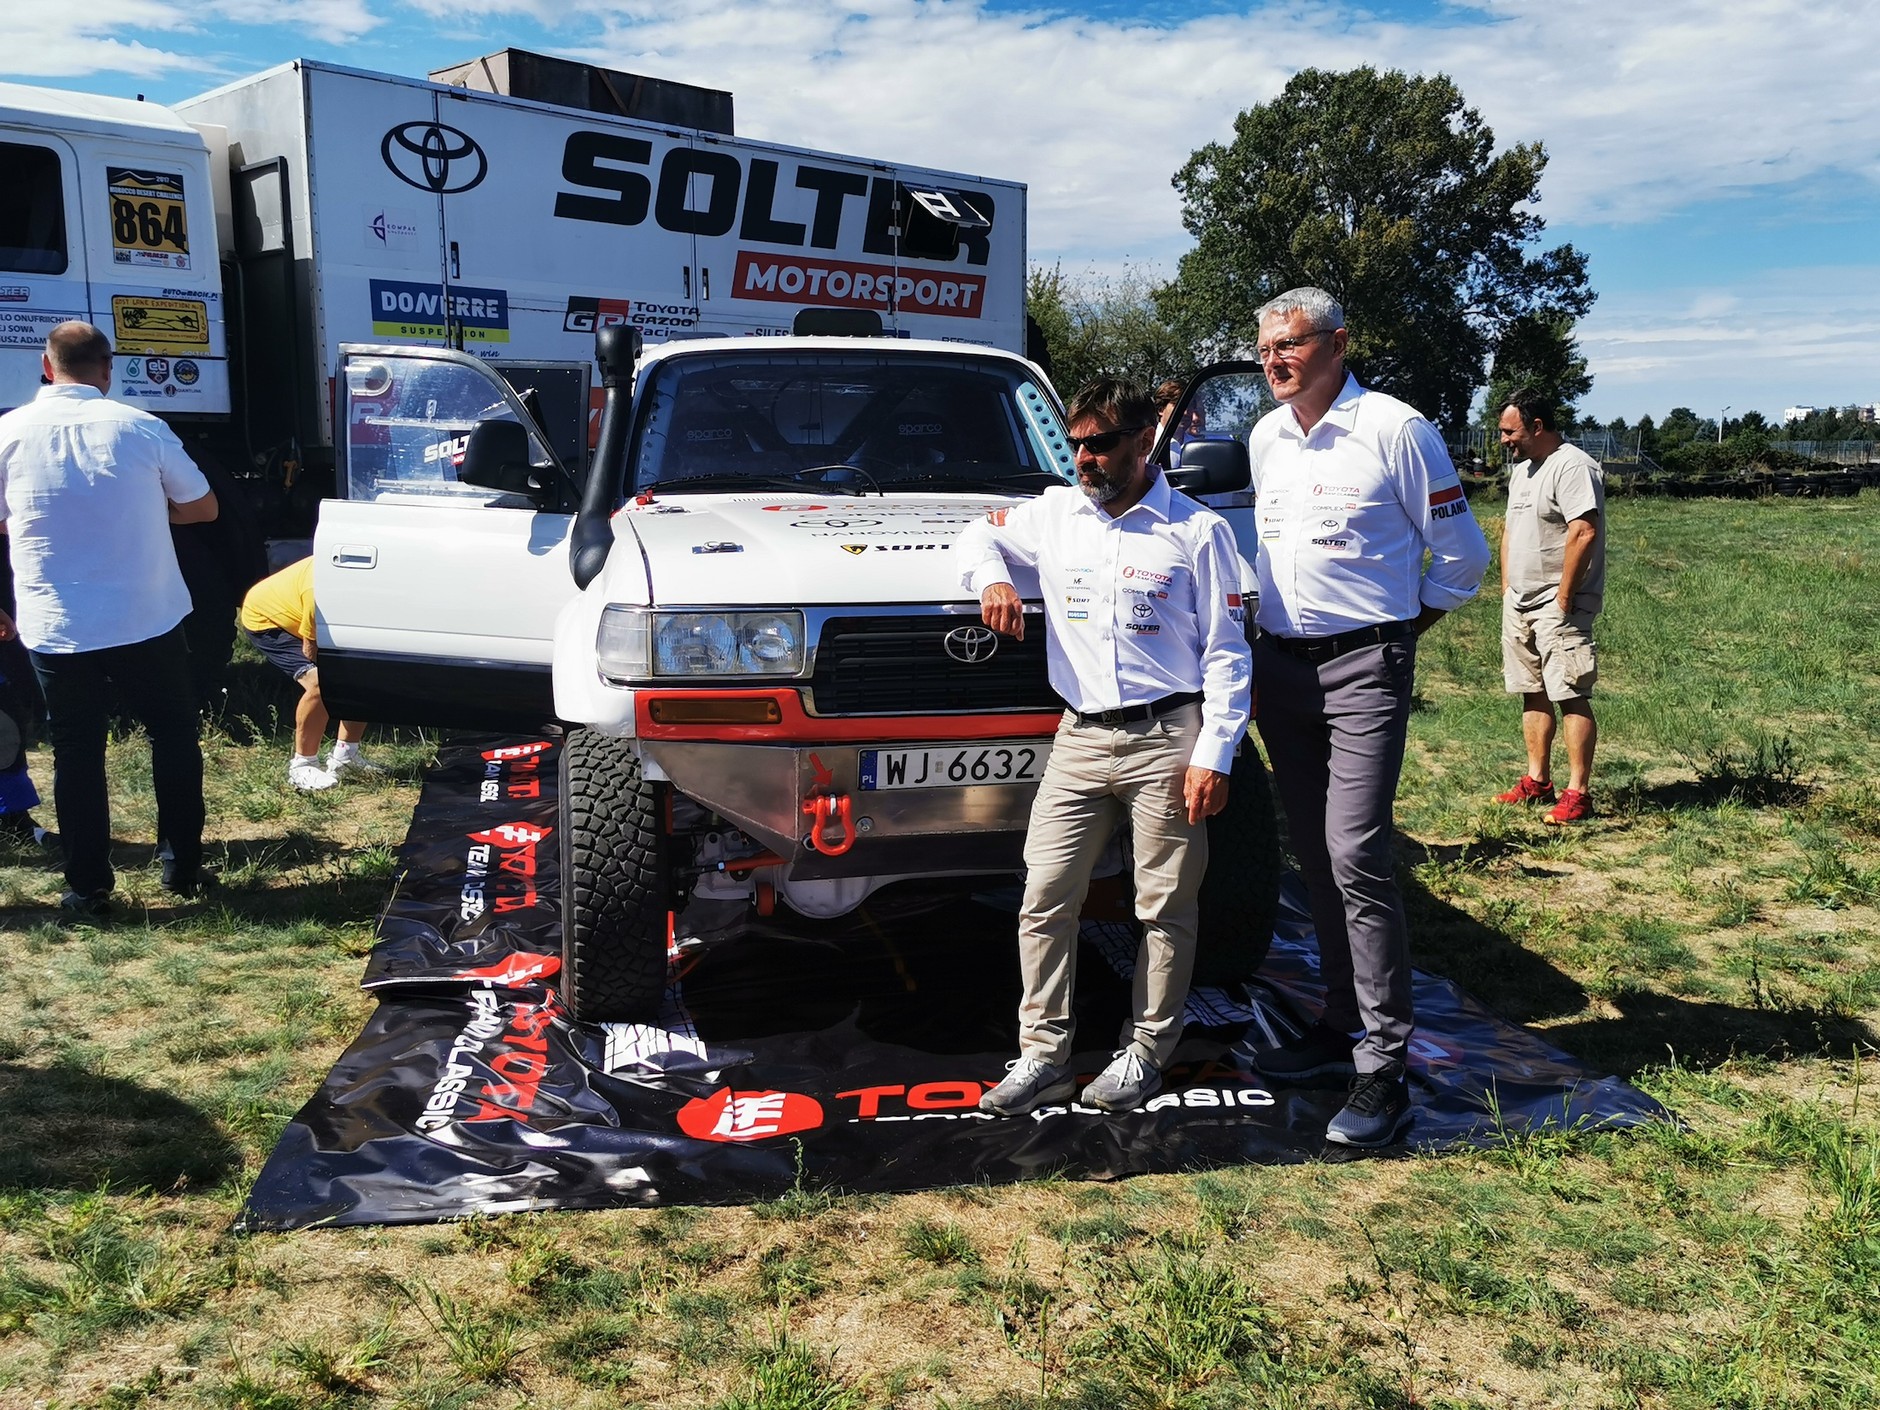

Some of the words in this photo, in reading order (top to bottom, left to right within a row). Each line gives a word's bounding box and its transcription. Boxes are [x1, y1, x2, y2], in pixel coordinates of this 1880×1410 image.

[136, 188, 156, 198] DESERT
[113, 199, 187, 250] 864
[744, 262, 978, 309] MOTORSPORT
[633, 301, 700, 316] TOYOTA
[631, 313, 694, 327] GAZOO
[8, 325, 35, 333] SOWA
[400, 326, 486, 339] SUSPEION
[687, 428, 733, 439] sparco
[898, 423, 943, 434] sparco
[1323, 485, 1360, 494] TOYOTA
[1431, 499, 1467, 521] POLAND
[1311, 538, 1348, 547] SOLTER
[1136, 568, 1173, 584] TOYOTA
[1125, 622, 1161, 632] SOLTER
[862, 775, 875, 785] PL
[886, 752, 929, 786] WJ
[947, 748, 1046, 782] 6632
[415, 1034, 484, 1130] CLASSIC
